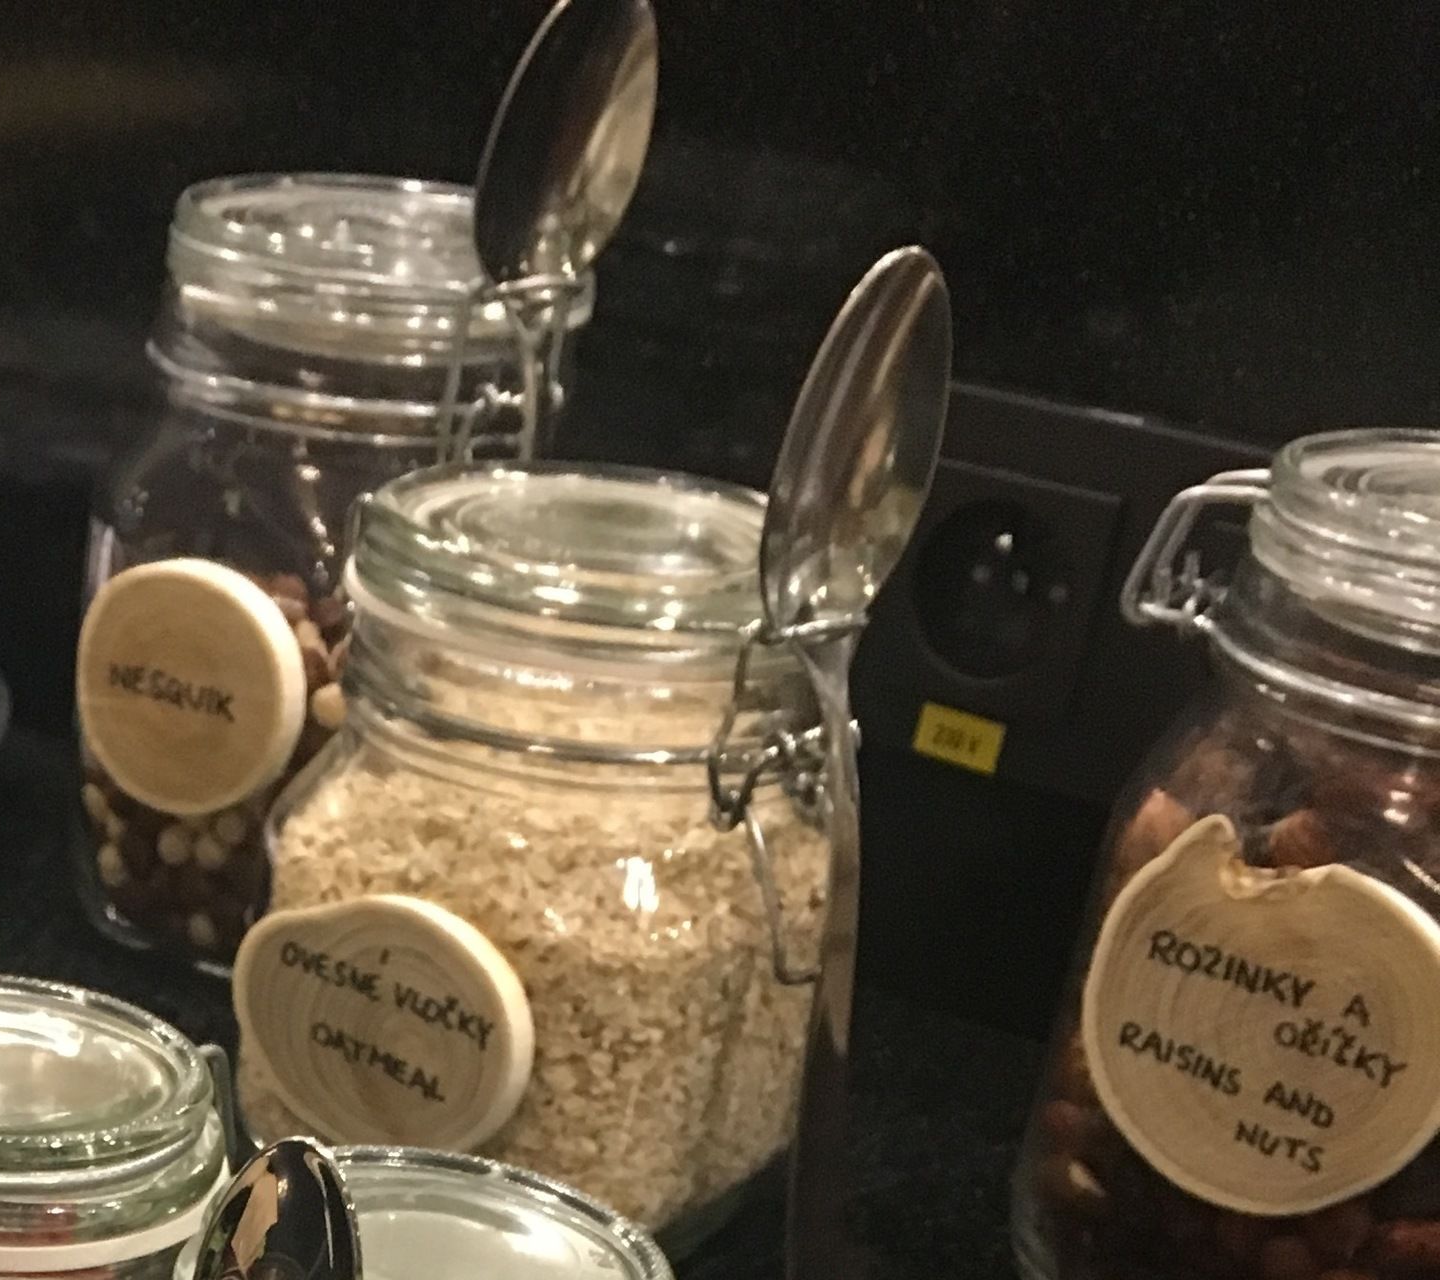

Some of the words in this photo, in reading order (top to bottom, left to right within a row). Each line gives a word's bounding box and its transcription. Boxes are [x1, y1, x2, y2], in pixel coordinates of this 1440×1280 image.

[1147, 928, 1316, 1009] ROZINKY
[1343, 994, 1371, 1028] A
[311, 1020, 447, 1103] OATMEAL
[1118, 1020, 1243, 1097] RAISINS
[1263, 1080, 1336, 1130] AND
[1233, 1119, 1327, 1174] NUTS
